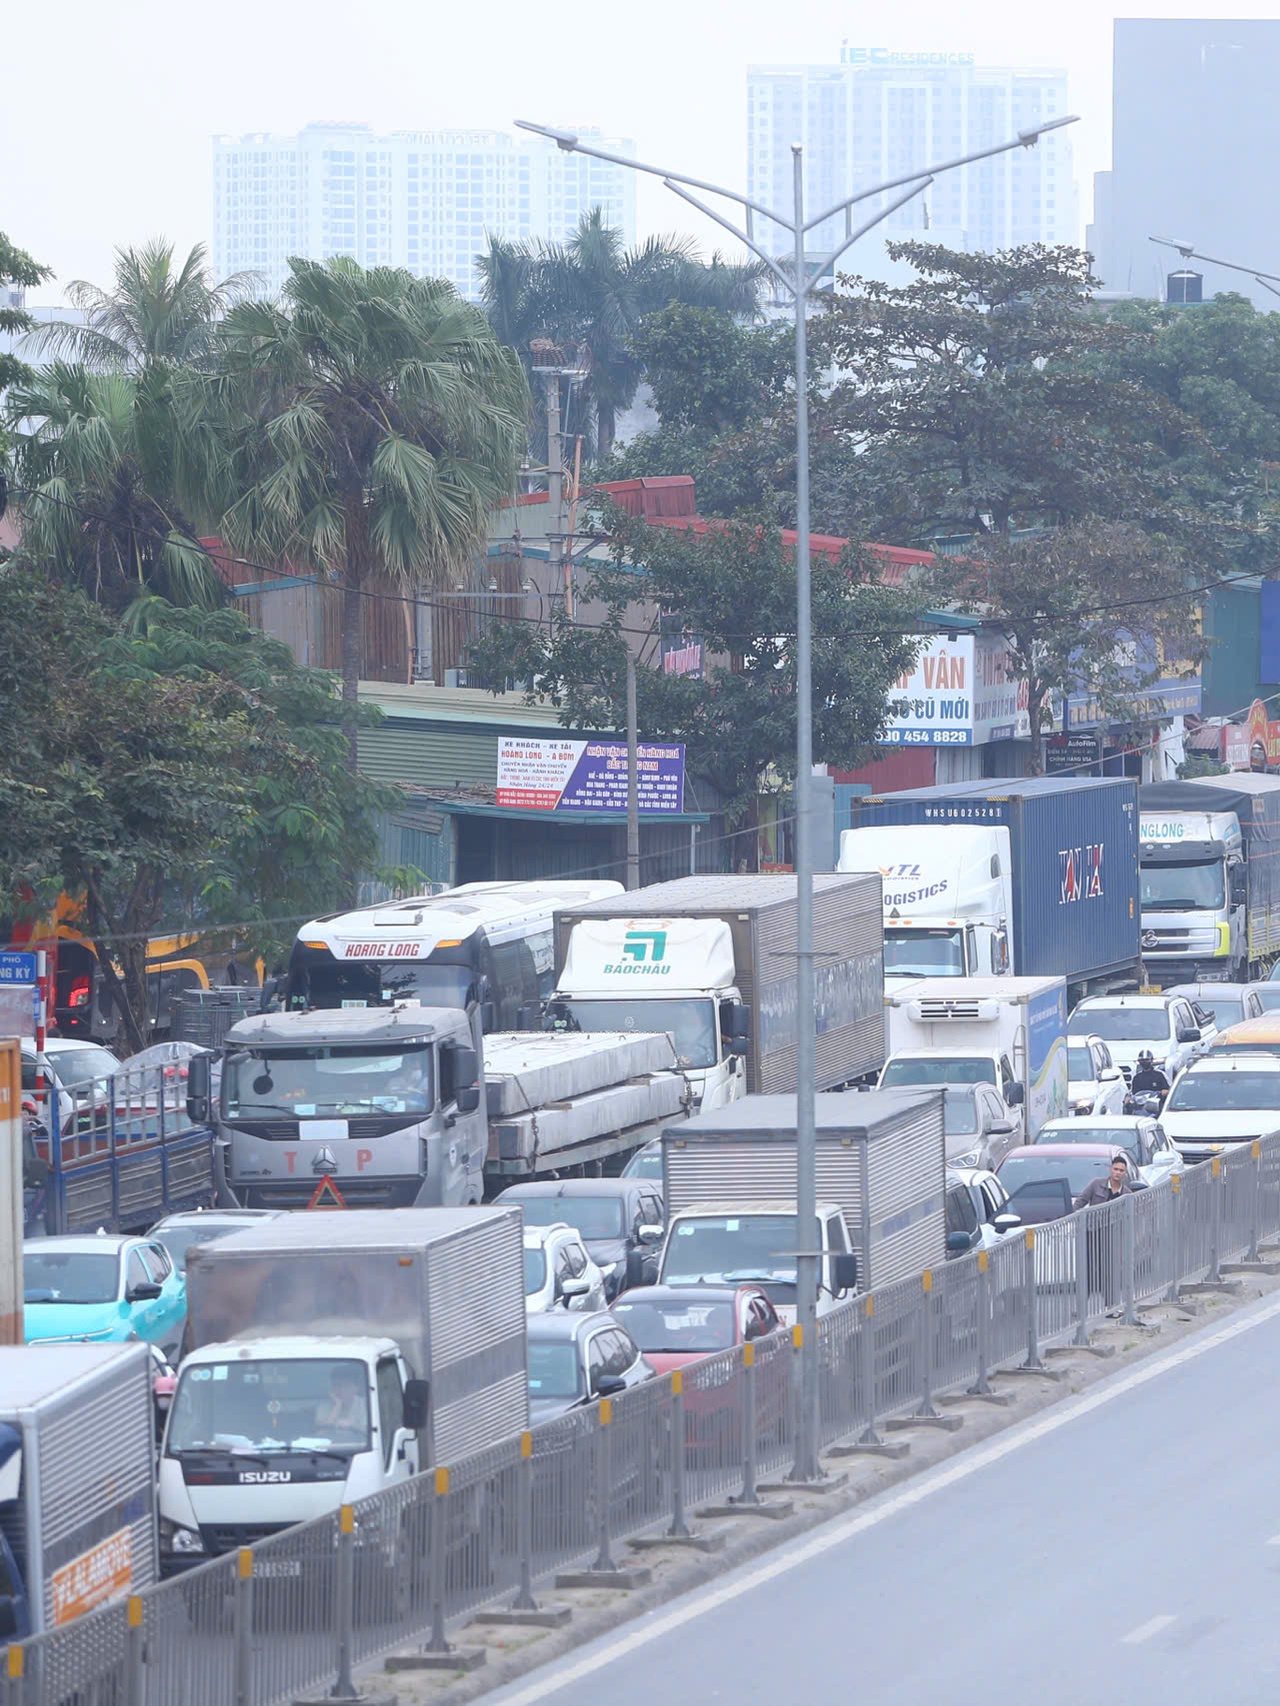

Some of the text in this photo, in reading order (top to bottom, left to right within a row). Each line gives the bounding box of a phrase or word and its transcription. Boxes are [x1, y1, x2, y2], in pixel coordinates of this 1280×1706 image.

[923, 649, 965, 690] VÂN
[914, 696, 935, 720] CŨ
[940, 696, 970, 720] MỚI
[904, 730, 930, 743] 454
[933, 730, 968, 743] 8828
[525, 750, 543, 760] LONG
[642, 761, 659, 771] NAM
[1140, 823, 1184, 838] NGLONG
[884, 879, 948, 906] OGISTICS
[388, 943, 420, 956] LONG
[15, 965, 31, 979] KỲ
[283, 1149, 373, 1174] T P
[239, 1471, 292, 1484] ISUZU
